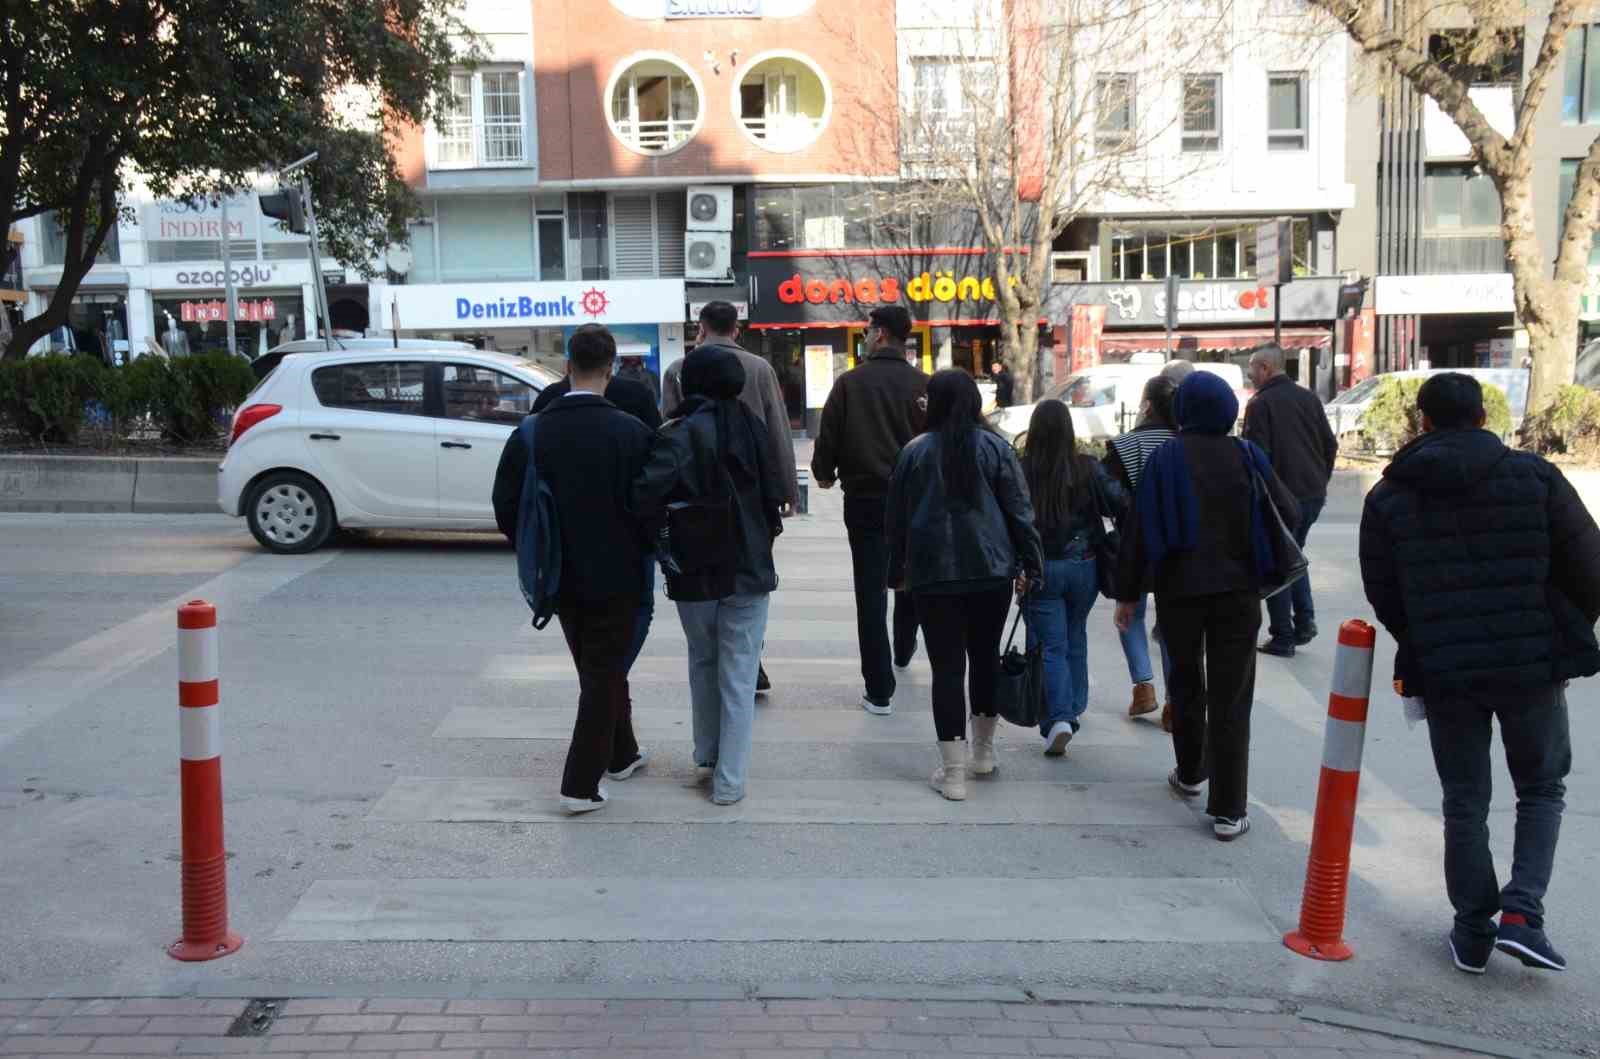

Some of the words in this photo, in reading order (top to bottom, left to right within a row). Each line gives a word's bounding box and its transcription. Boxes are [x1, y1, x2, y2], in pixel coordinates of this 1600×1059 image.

[161, 217, 243, 237] İNDİRM
[177, 265, 270, 285] azapoğlu
[778, 274, 899, 303] donas
[456, 295, 575, 319] DenizBank
